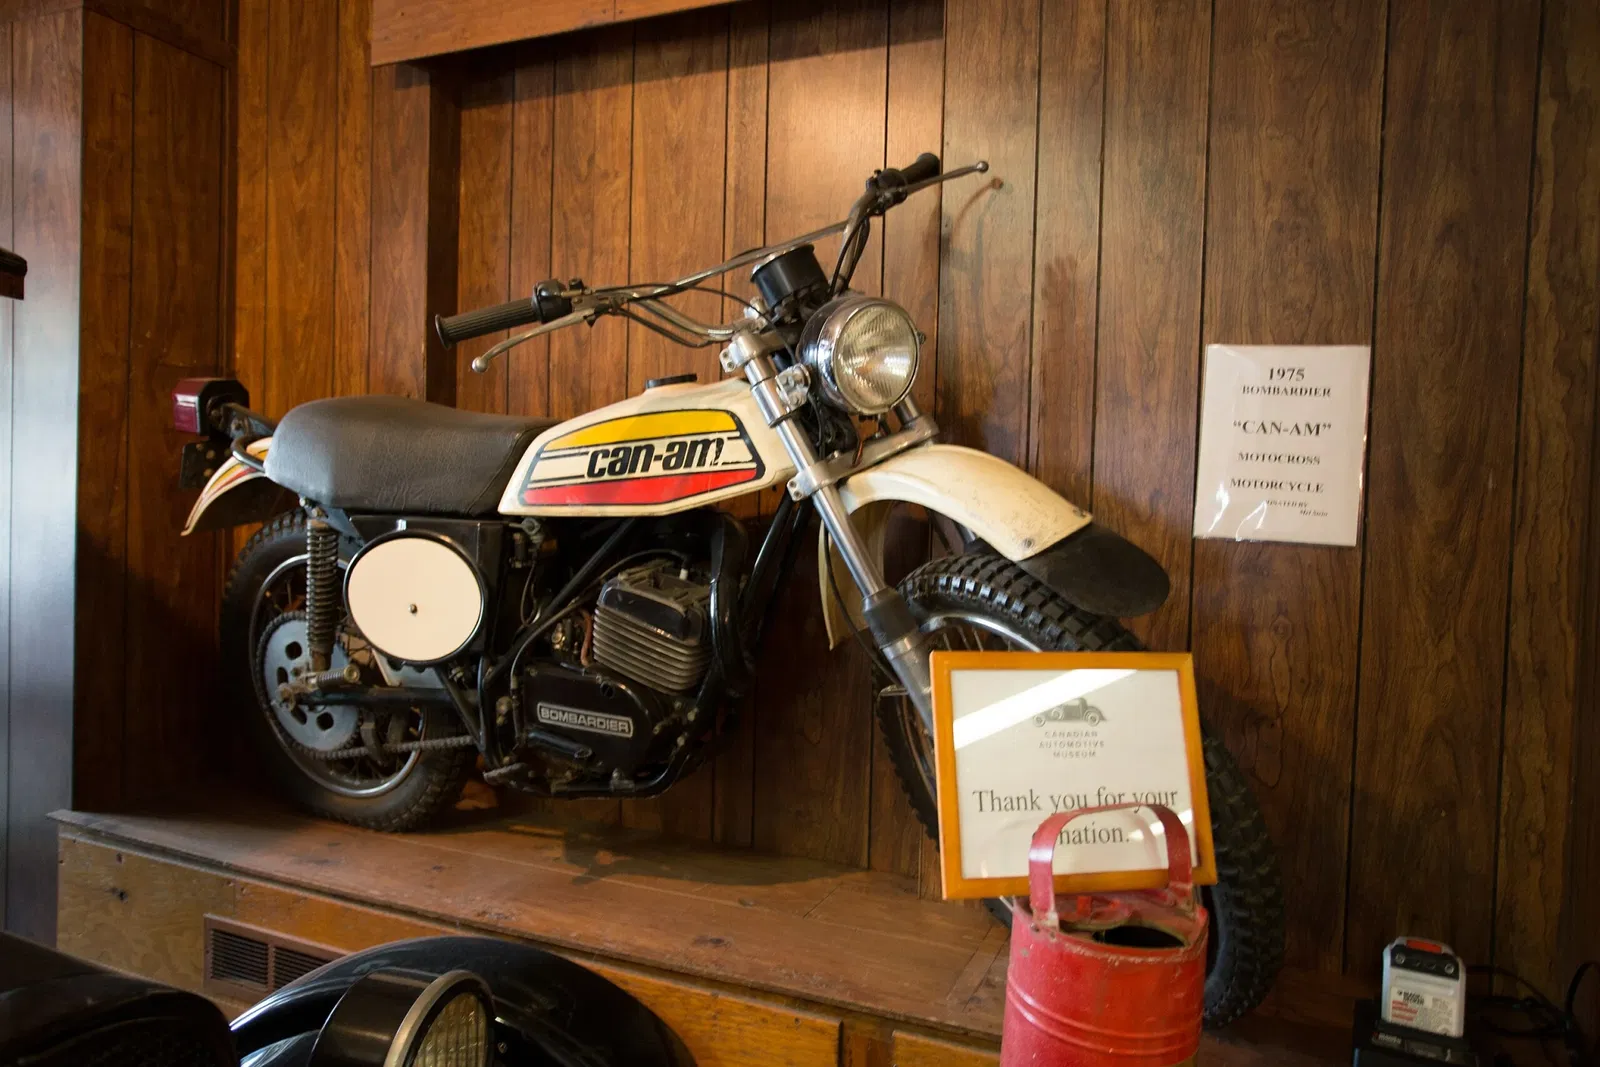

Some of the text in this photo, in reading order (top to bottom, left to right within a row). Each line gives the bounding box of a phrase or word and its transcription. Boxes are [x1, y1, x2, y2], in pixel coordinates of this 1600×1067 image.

[1268, 367, 1305, 381] 1975
[1242, 385, 1332, 398] BOMBARDIER
[1233, 420, 1332, 437] “CAN-AM”
[586, 437, 725, 479] can-am
[1237, 452, 1321, 466] MOTOCROSS
[1230, 478, 1325, 494] MOTORCYCLE
[540, 706, 629, 733] BOMBARDIER
[1044, 730, 1098, 739] CANADIAN
[1039, 740, 1105, 749] AUTOMOTIVE
[1052, 750, 1097, 759] MUSEUM
[972, 786, 1178, 815] Thank you for your
